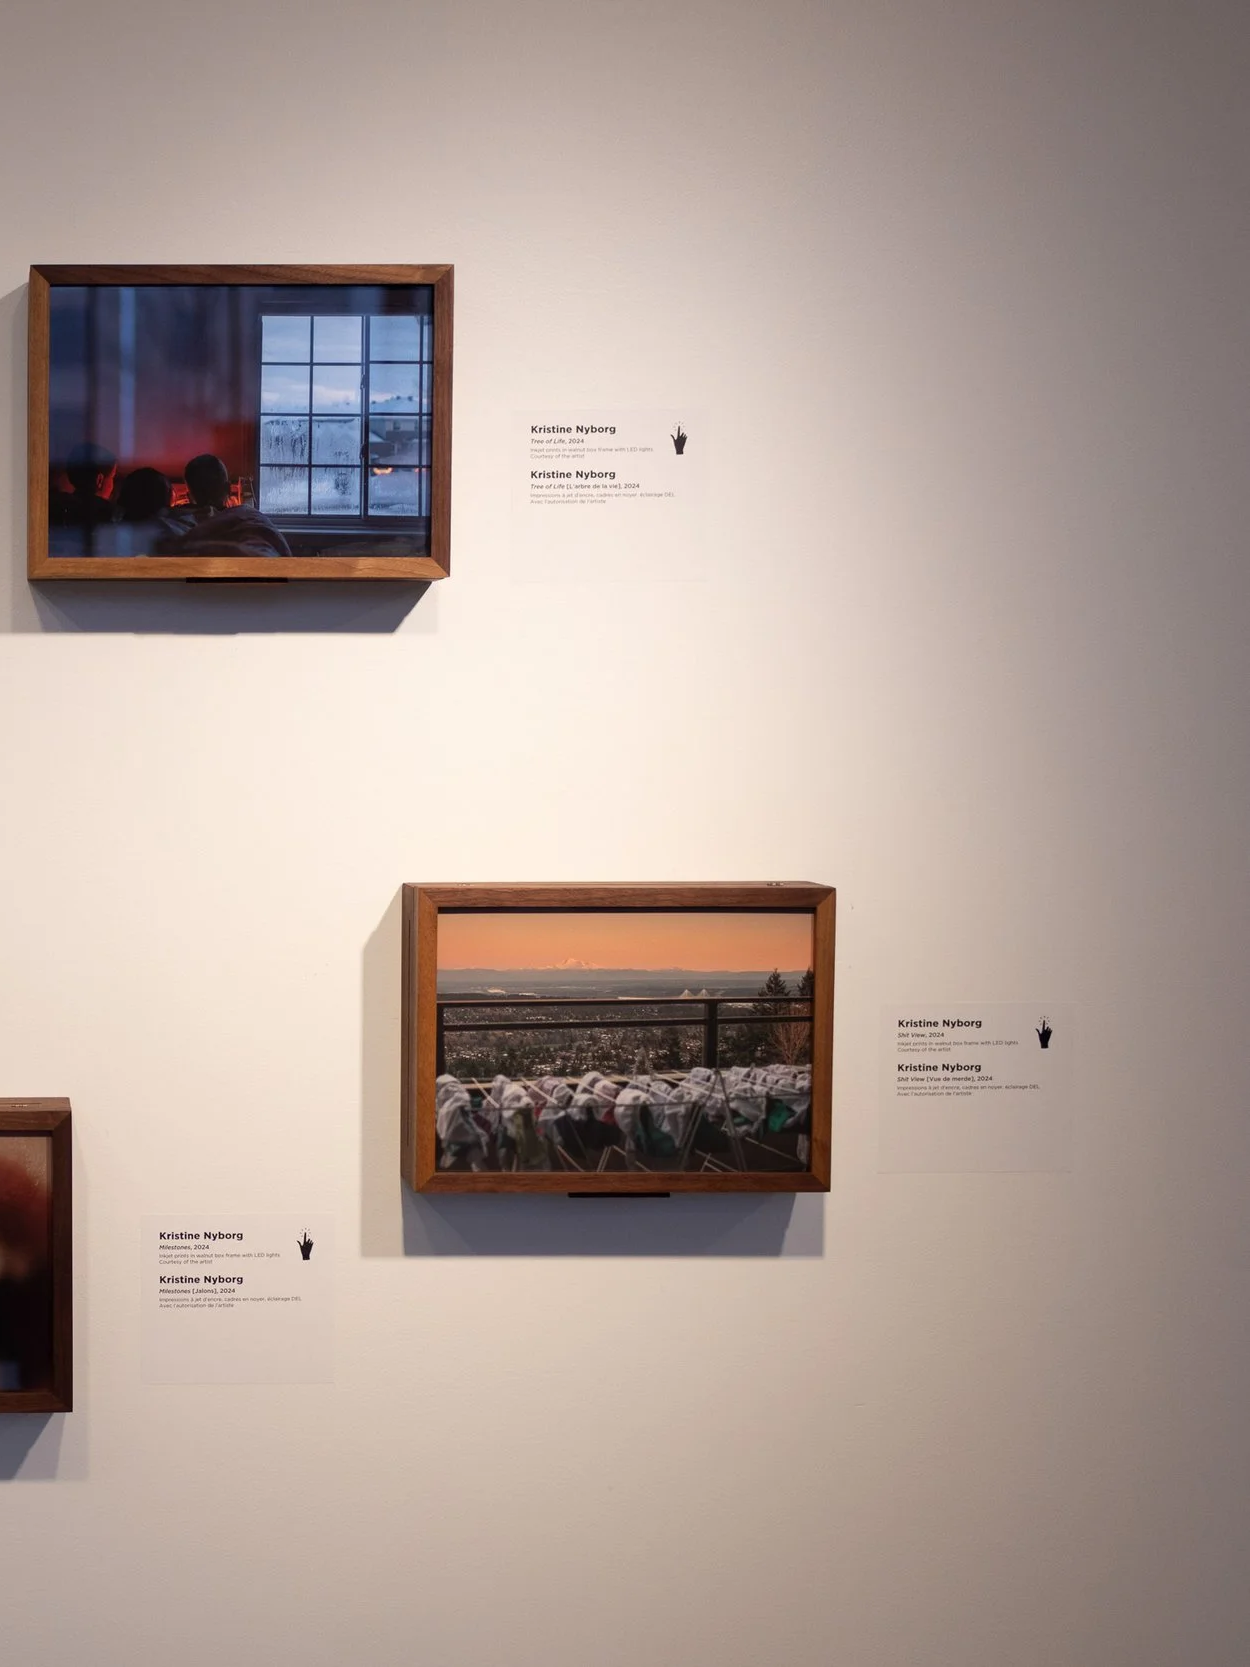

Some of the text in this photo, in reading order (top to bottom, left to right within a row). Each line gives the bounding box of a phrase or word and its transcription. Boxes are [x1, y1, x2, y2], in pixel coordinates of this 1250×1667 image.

[531, 425, 616, 435] Kristine Nyborg
[576, 470, 615, 480] Nyborg
[898, 1019, 982, 1029] Kristine Nyborg
[942, 1063, 981, 1073] Nyborg
[160, 1232, 243, 1241] Kristine Nyborg
[204, 1275, 243, 1285] Nyborg
